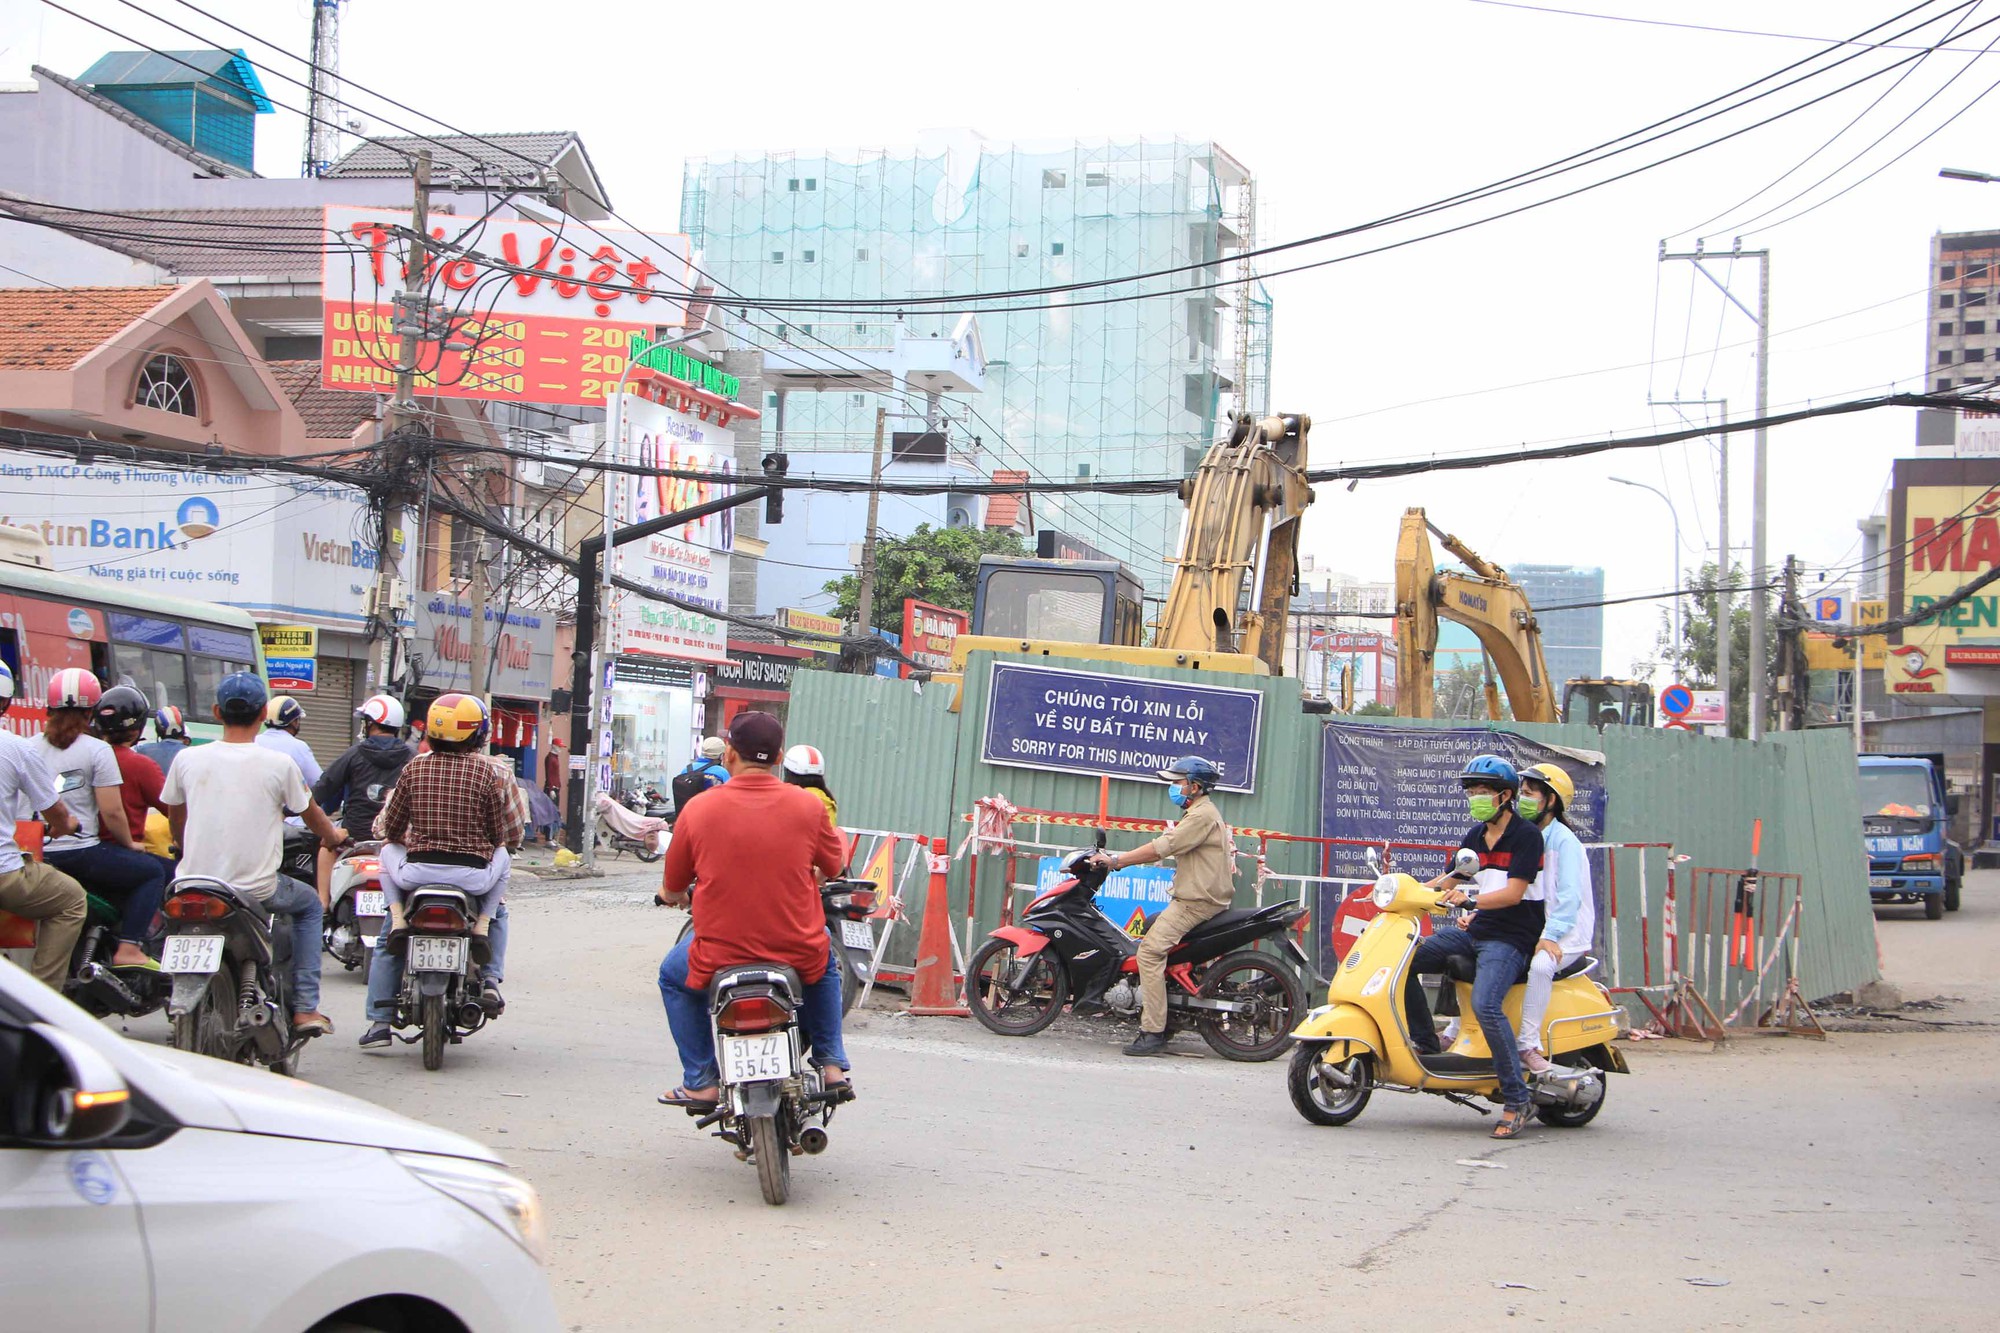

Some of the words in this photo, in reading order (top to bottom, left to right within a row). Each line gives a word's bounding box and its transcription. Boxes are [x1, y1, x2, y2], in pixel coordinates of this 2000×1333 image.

[502, 232, 660, 317] Việt
[331, 364, 437, 389] NHUM
[459, 371, 524, 394] 400
[37, 465, 80, 479] TMCP
[215, 473, 248, 485] Nam
[303, 532, 381, 570] VietinBan
[89, 565, 124, 581] Nâng
[127, 565, 147, 583] giá
[150, 567, 165, 581] trị
[169, 568, 203, 582] cuộc
[208, 568, 239, 585] sống
[1044, 688, 1105, 710] CHÚNG
[1111, 695, 1138, 713] TÔI
[1142, 702, 1170, 717] XIN
[1175, 699, 1204, 721] LỖI
[1035, 708, 1057, 729] VỀ
[1062, 714, 1088, 733] SỰ
[1090, 715, 1125, 736] BẤT
[1129, 721, 1168, 743] TIỆN
[1173, 726, 1208, 746] NÀY
[1012, 738, 1056, 757] SORRY
[1059, 743, 1085, 760] FOR
[1088, 746, 1117, 764] THIS
[1120, 750, 1226, 776] INCONVEE
[1864, 826, 1891, 834] UZU
[1132, 878, 1146, 900] THI
[173, 939, 214, 953] 30-P4
[170, 955, 211, 970] 3974
[418, 955, 453, 968] 3019
[733, 1037, 778, 1058] 51-Z7
[735, 1057, 780, 1078] 5545
